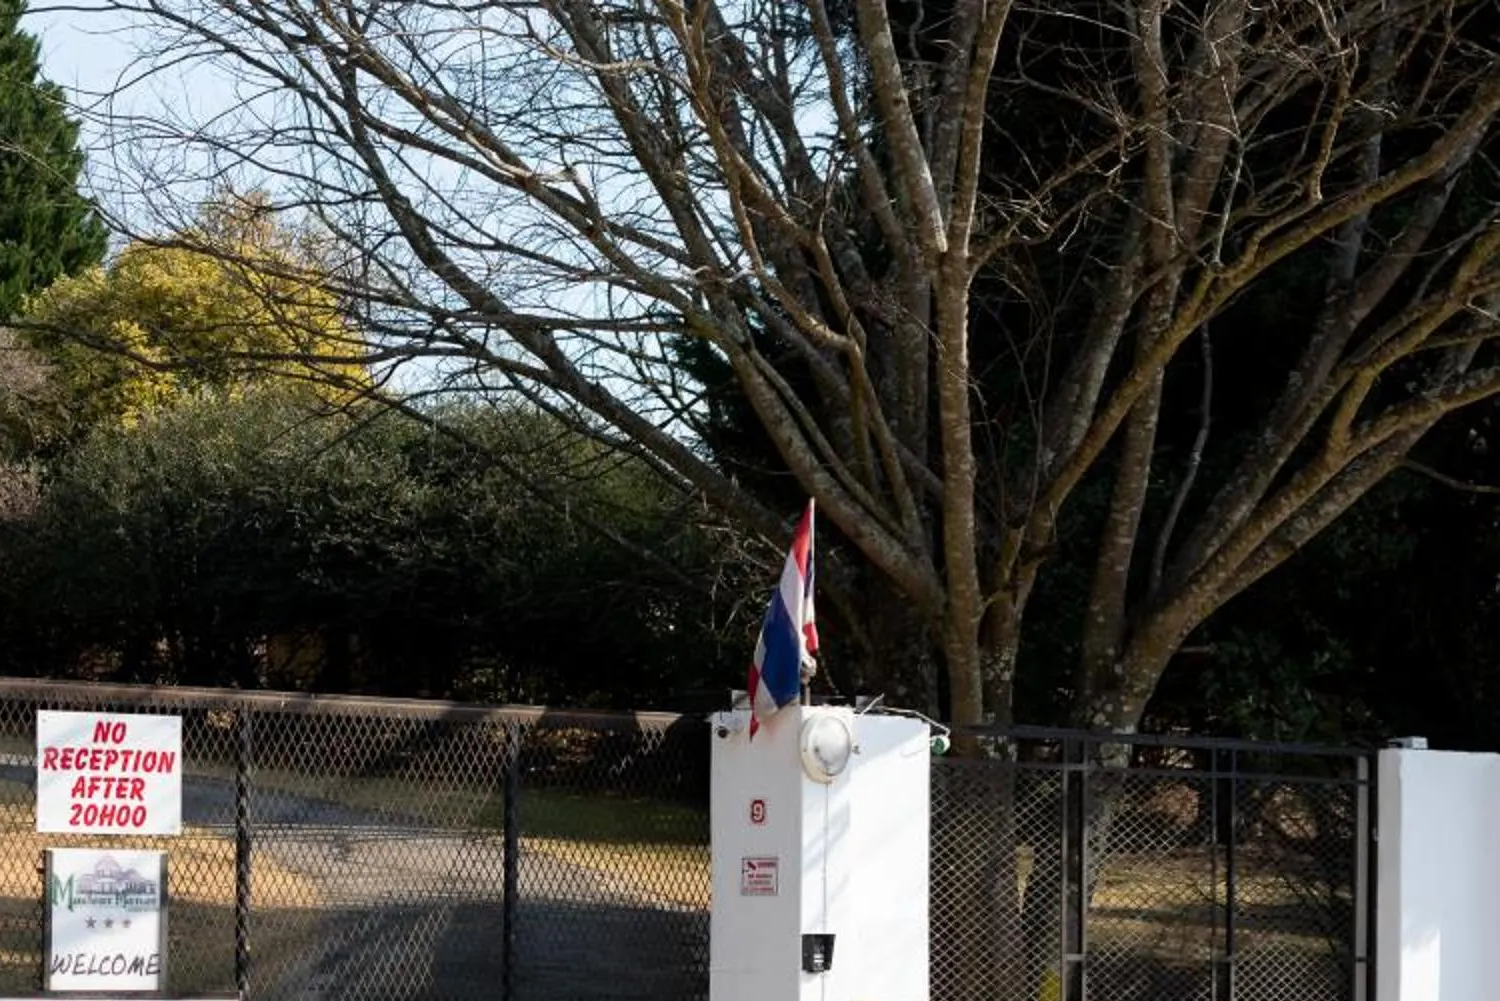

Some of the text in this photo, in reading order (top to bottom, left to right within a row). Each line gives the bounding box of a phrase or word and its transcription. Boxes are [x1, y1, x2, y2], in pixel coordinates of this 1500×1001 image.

[93, 721, 127, 744] NO
[42, 748, 176, 774] RECEPTION
[70, 777, 146, 802] AFTER
[68, 804, 147, 828] 20H00
[752, 801, 764, 821] 9
[50, 952, 161, 976] WELCOME
